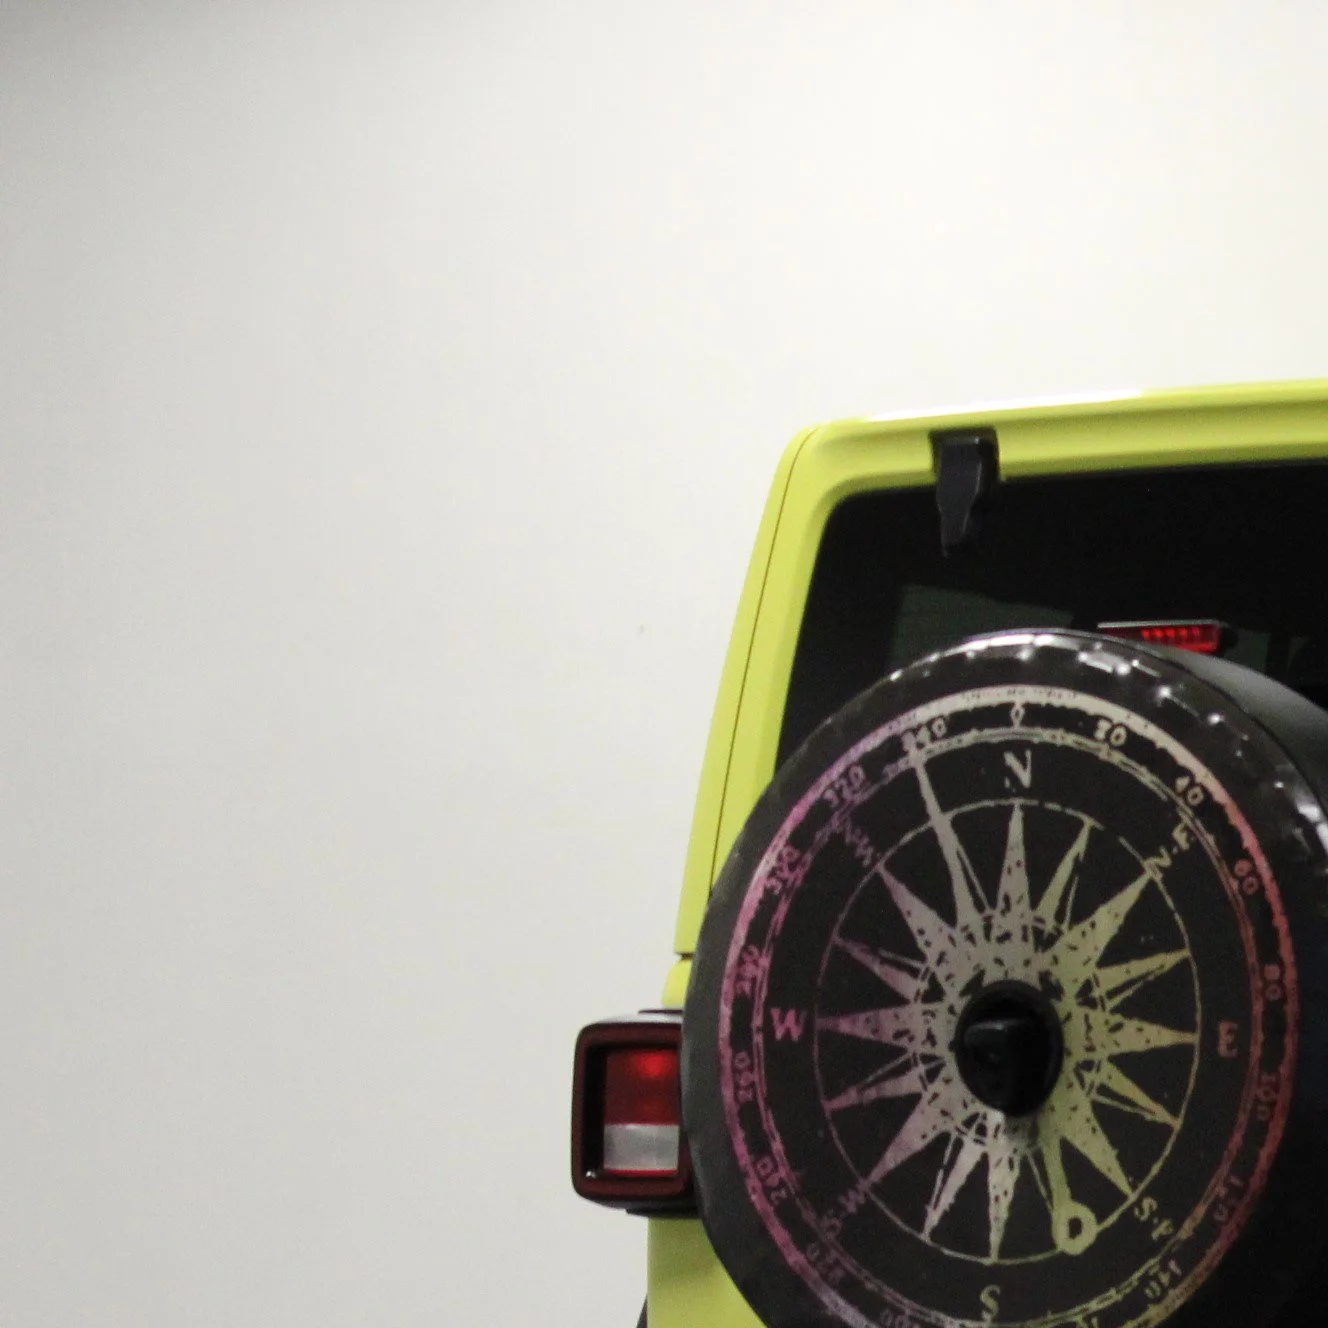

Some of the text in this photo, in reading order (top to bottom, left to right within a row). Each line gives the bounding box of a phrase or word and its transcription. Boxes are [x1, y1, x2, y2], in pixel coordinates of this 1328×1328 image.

[1004, 748, 1032, 791] N
[1175, 775, 1205, 806] 40
[771, 1008, 808, 1042] W
[1218, 1021, 1238, 1058] E
[980, 1284, 1001, 1321] S
